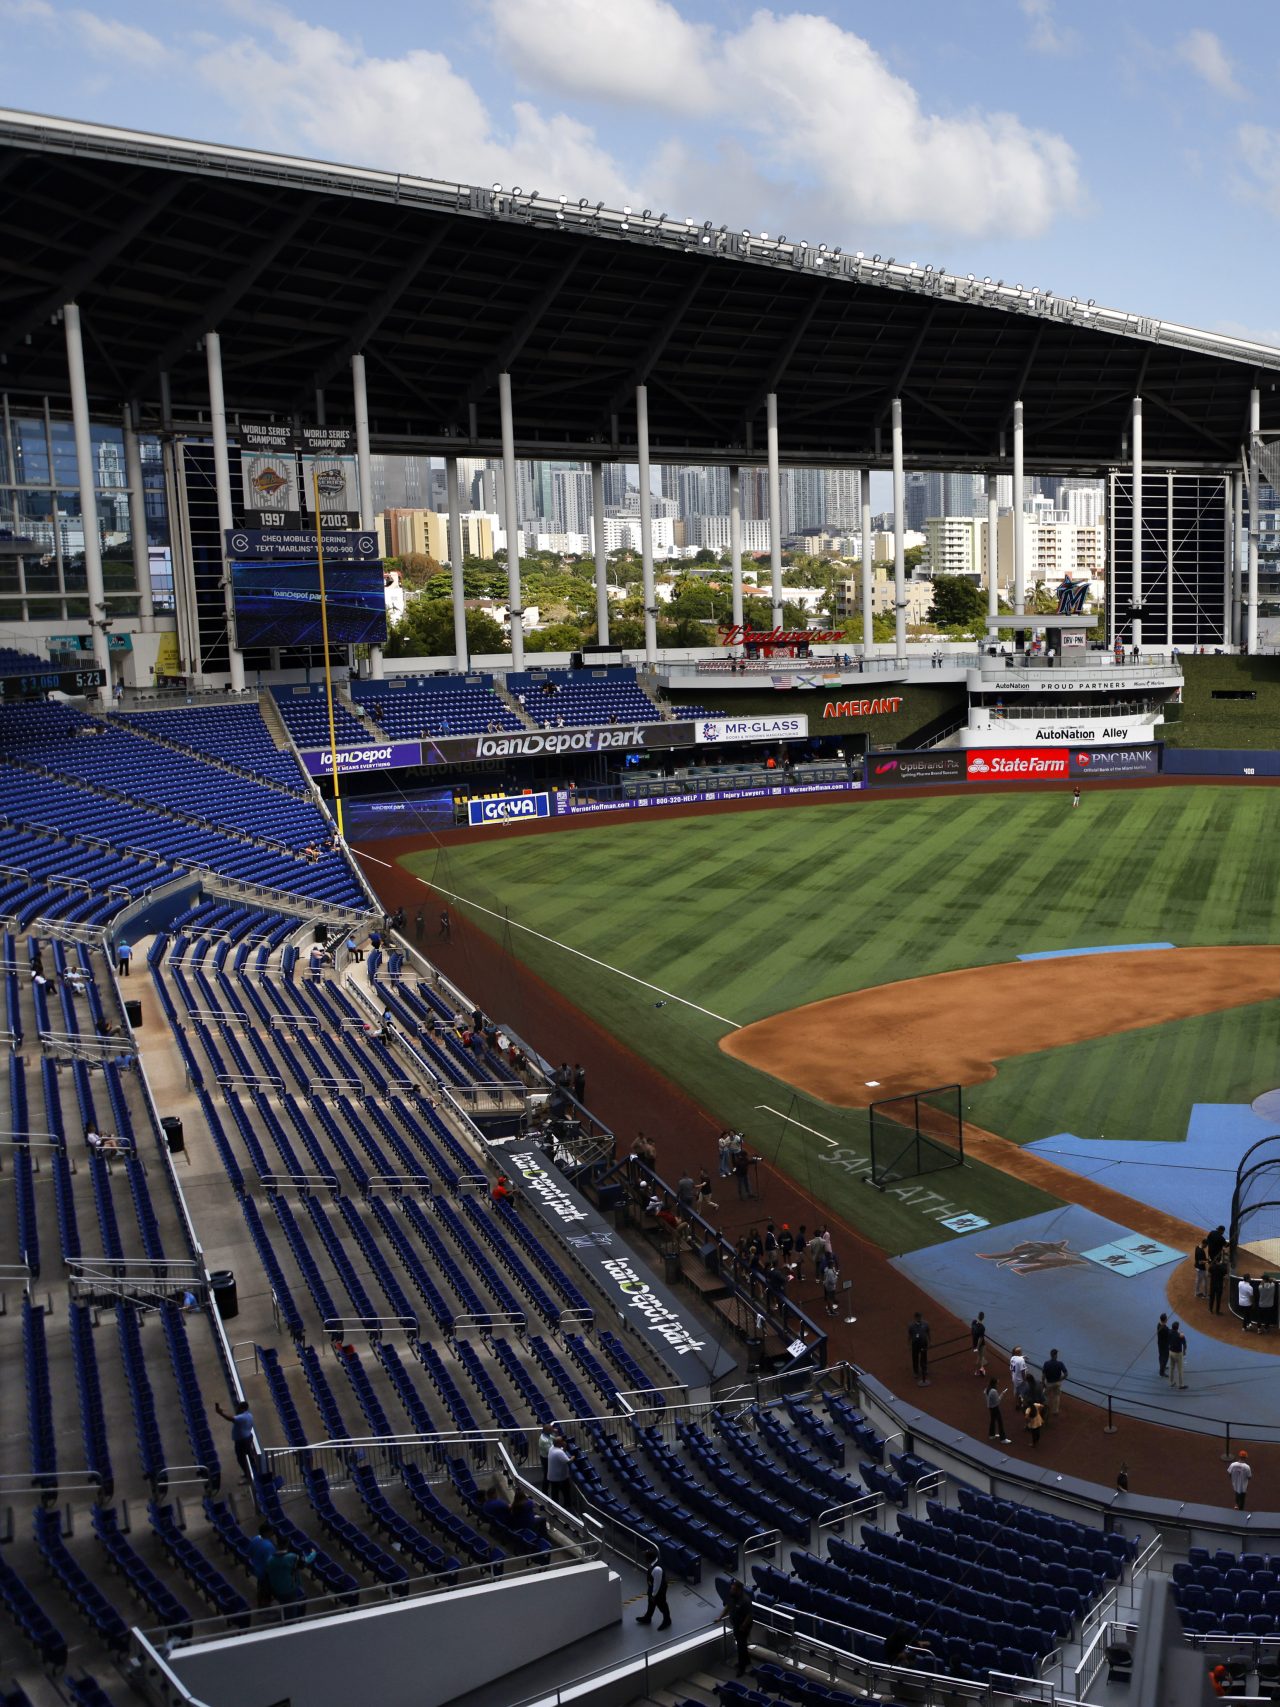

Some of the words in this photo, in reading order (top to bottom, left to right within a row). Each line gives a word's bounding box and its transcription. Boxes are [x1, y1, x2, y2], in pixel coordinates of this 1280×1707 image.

[242, 425, 266, 436] WORLD
[268, 426, 290, 436] SERIES
[304, 429, 327, 438] WORLD
[328, 430, 350, 439] SERIES
[247, 435, 286, 446] CHAMPIONS
[308, 439, 346, 448] CHAMPIONS
[260, 513, 285, 526] 1997
[320, 514, 348, 526] 2003
[312, 536, 346, 544] ODERING
[718, 624, 847, 646] Budweiser
[76, 672, 100, 687] 5:23
[996, 682, 1030, 690] AutoNation
[823, 697, 903, 718] AMERANT
[1036, 730, 1094, 740] AutoNation
[1102, 728, 1128, 738] Alley
[476, 730, 596, 758] loanDepot
[596, 726, 644, 750] park
[342, 764, 359, 772] MEANS
[360, 762, 390, 770] EVERYTHING
[742, 789, 764, 798] Lawyers
[485, 800, 534, 819] GOYA
[570, 802, 630, 814] WernerHoffman.com
[541, 1194, 590, 1223] park
[601, 1257, 679, 1323] loanDepot
[648, 1321, 706, 1354] park
